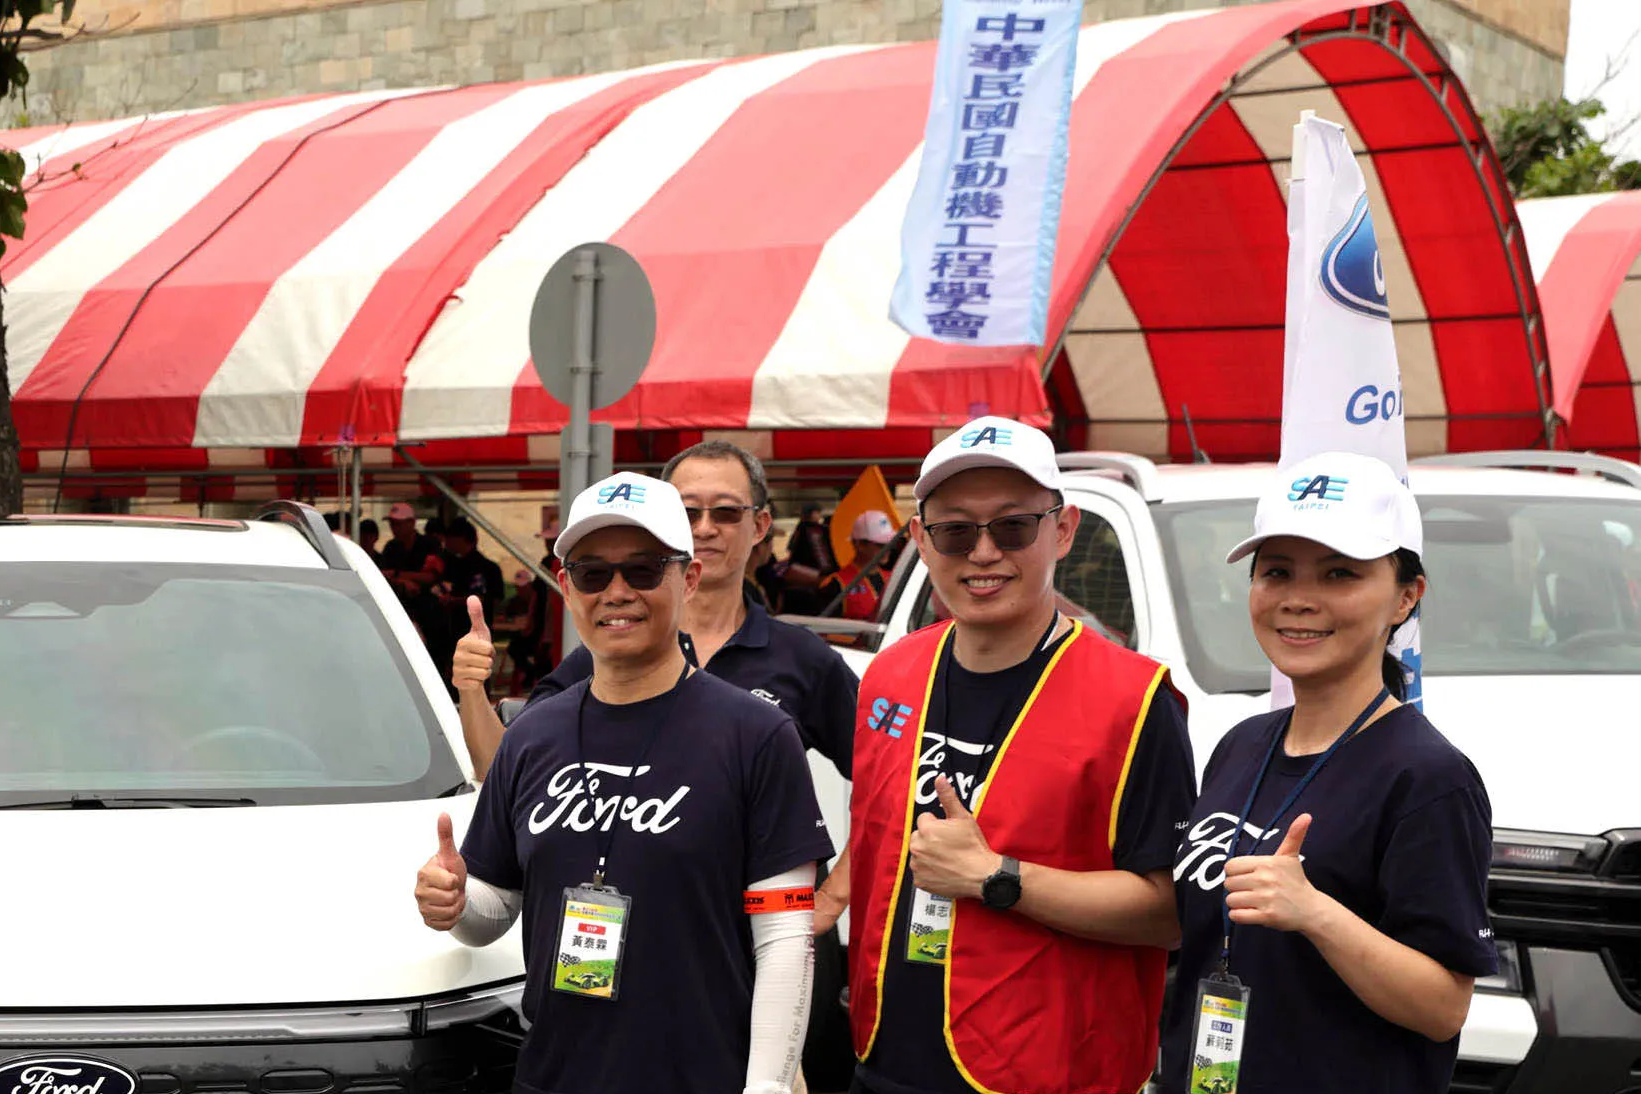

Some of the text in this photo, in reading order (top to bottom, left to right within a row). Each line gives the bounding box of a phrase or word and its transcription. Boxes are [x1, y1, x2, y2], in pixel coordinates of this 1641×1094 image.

[926, 13, 1046, 340] 中華民國自動機工程學會
[960, 426, 1012, 448] SAE
[598, 483, 646, 504] SAE
[1287, 474, 1349, 501] SAE
[868, 697, 913, 738] SAE
[528, 763, 690, 834] Ford
[788, 1022, 801, 1043] For
